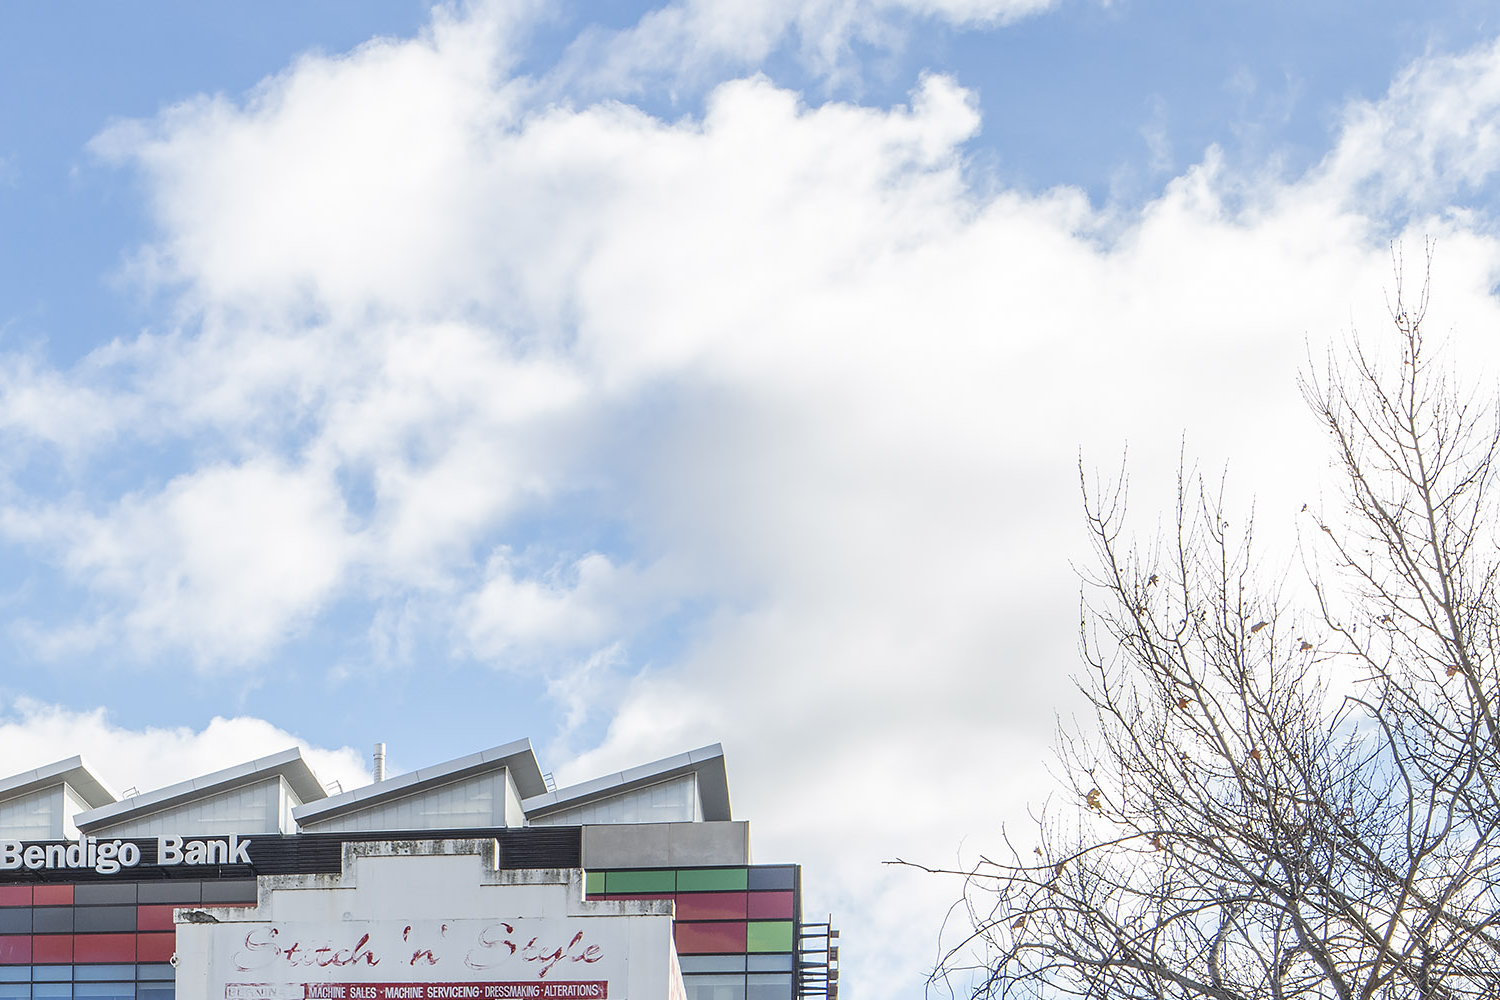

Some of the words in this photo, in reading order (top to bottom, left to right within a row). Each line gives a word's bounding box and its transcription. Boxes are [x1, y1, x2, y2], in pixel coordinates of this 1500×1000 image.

[157, 833, 252, 866] Bank
[234, 926, 381, 973] Stitch
[463, 922, 605, 979] Style
[308, 987, 346, 999] MACHINE
[350, 986, 377, 999] SALES
[385, 986, 423, 999] MACHINE
[427, 985, 480, 999] SERVICEING
[485, 985, 540, 998] DRESSMAKING
[544, 984, 599, 997] ALTERATIONS
